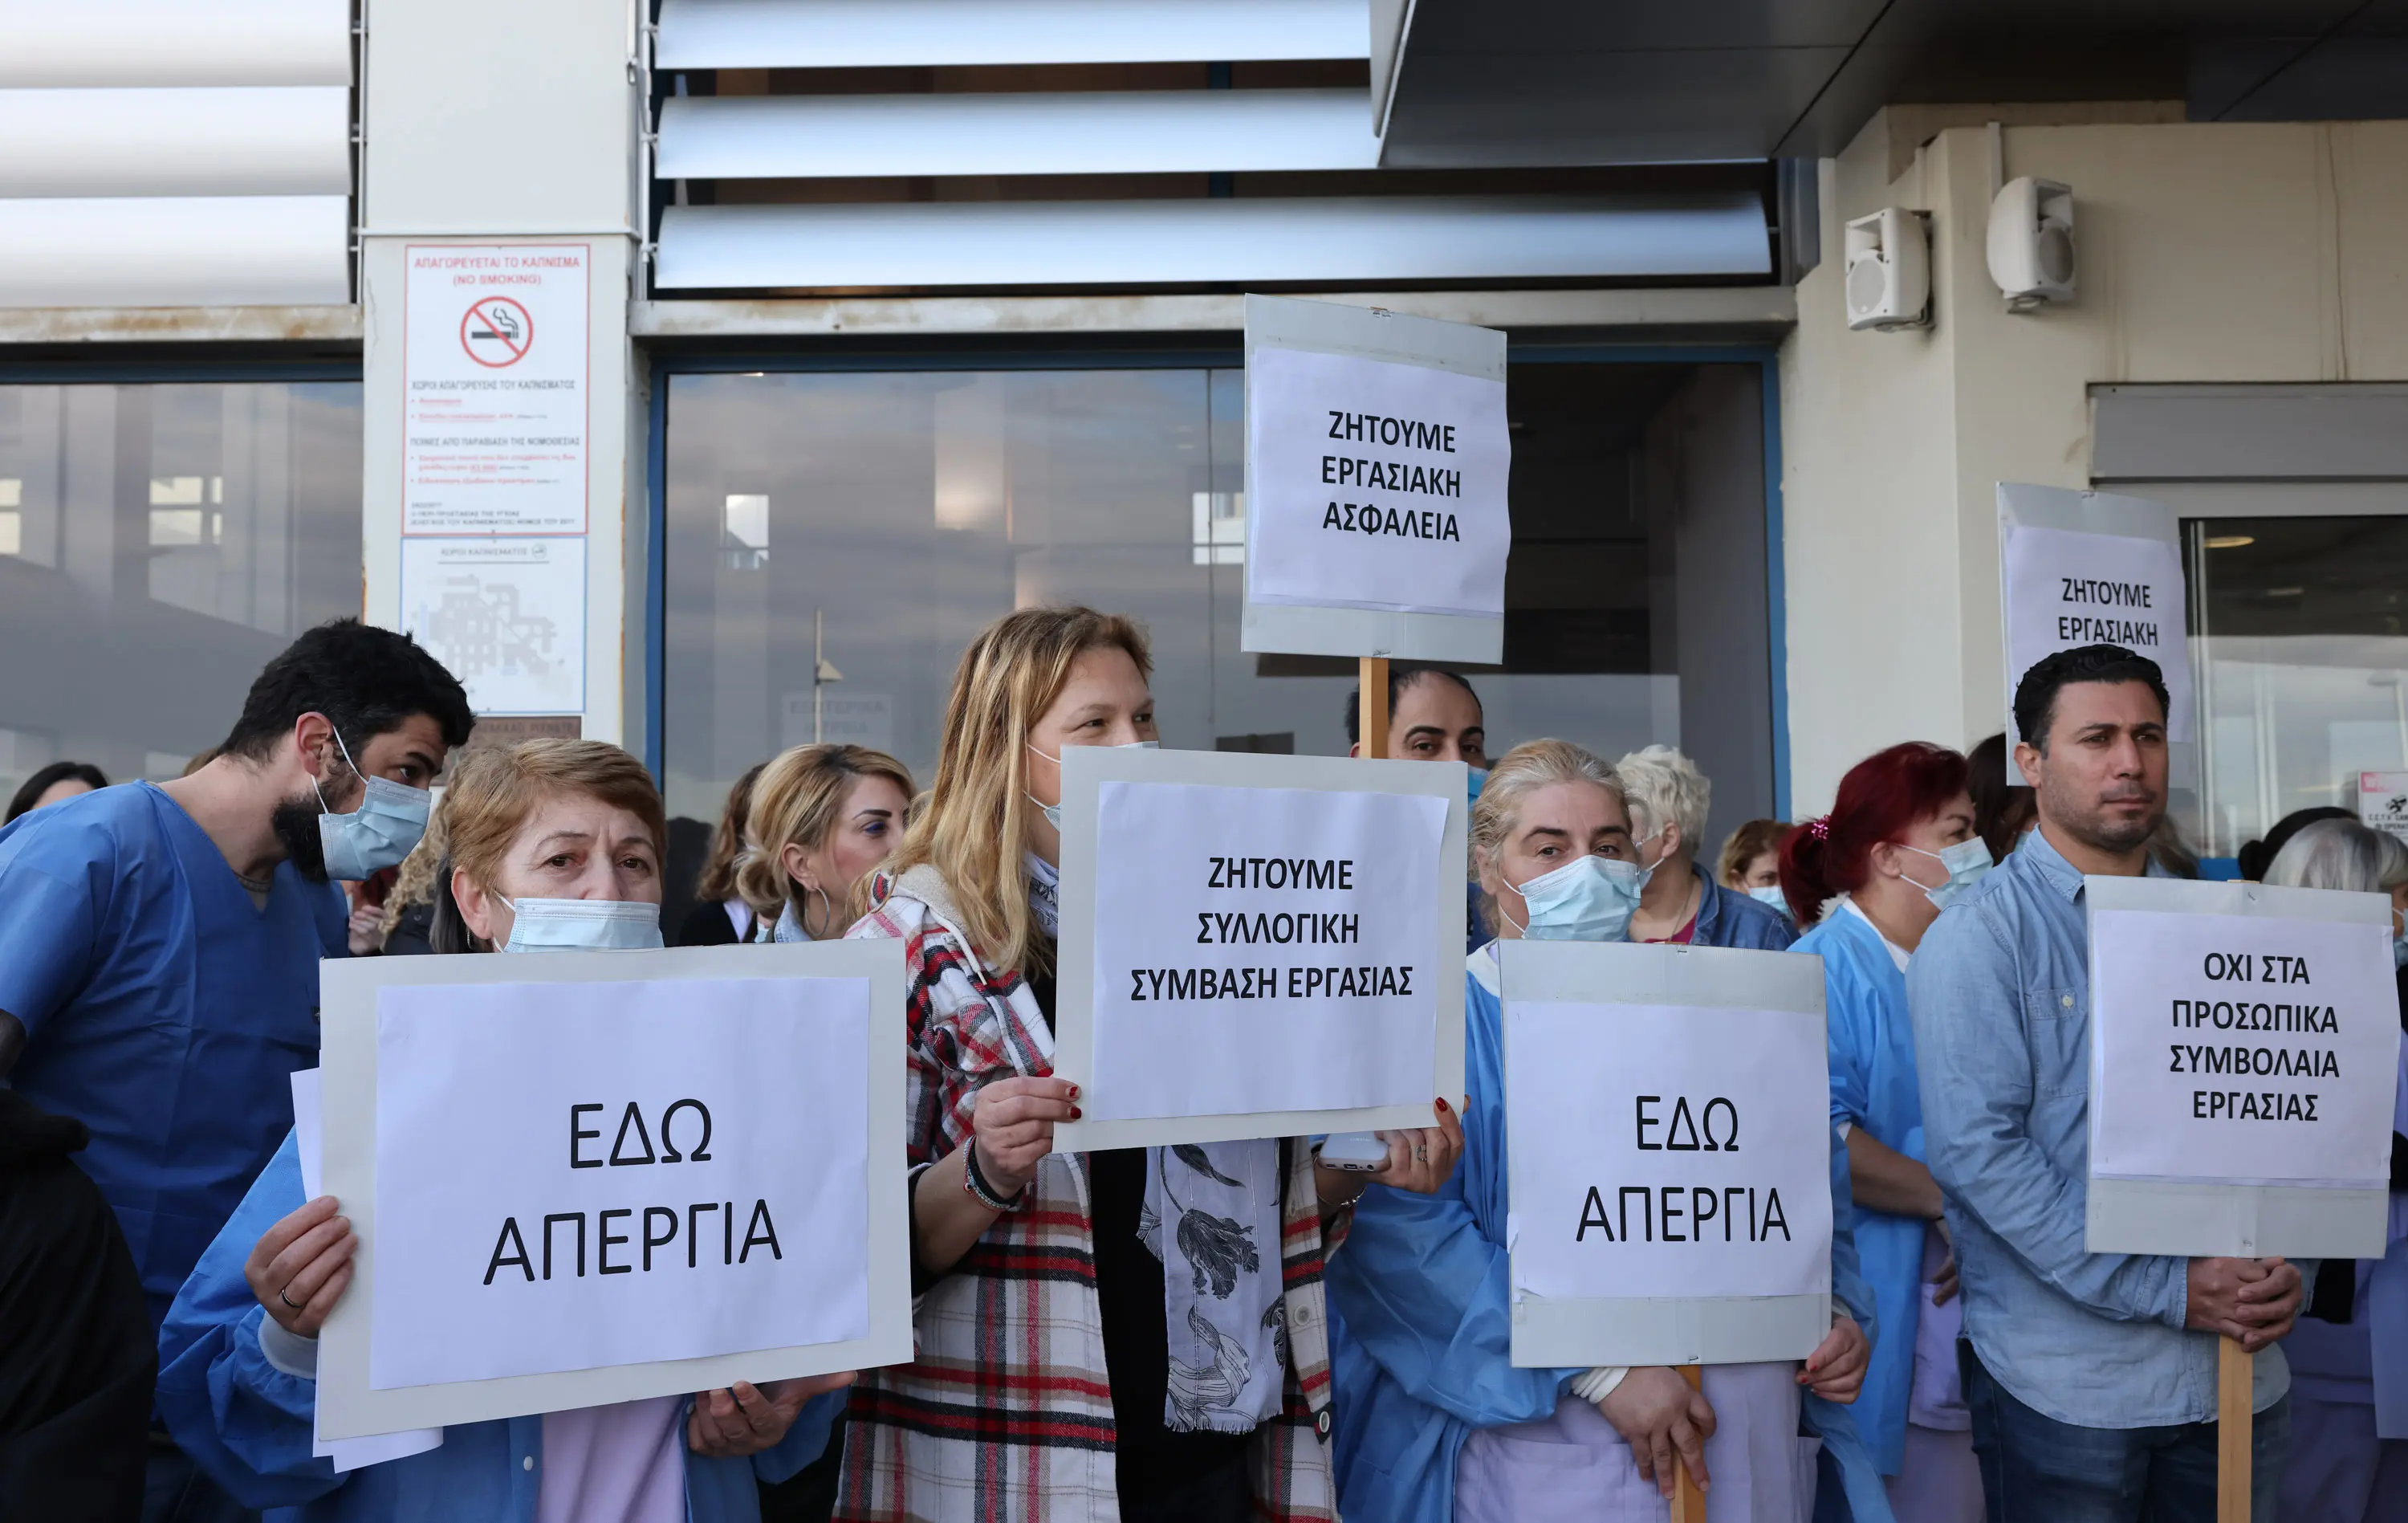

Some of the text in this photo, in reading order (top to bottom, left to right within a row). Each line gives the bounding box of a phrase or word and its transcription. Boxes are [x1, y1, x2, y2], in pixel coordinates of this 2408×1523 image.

[414, 256, 580, 269] ΑΠΑΓΟΡΕΥΕΤΑΙ ΤΟ ΚΑΠΝΙΣΜΑ
[453, 274, 542, 286] (NO SMOKING)
[499, 380, 516, 390] ΤΟΥ
[1328, 410, 1456, 454] ΖΗΤΟΥΜΕ
[1322, 455, 1461, 499] ΕΡΓΑΣΙΑΚΗ
[1322, 501, 1460, 543] ΑΣΦΑΛΕΙΑ
[2061, 577, 2152, 609] ΖΗΤΟΥΜΕ
[2058, 616, 2158, 646] ΕΡΓΑΣΙΑΚΗ
[1208, 857, 1353, 890] ΖΗΤΟΥΜΕ
[1197, 912, 1359, 944] ΣΥΛΛΟΓΙΚΗ
[1130, 966, 1413, 1001] ΣΥΜΒΑΣΗ ΕΡΓΑΣΙΑΣ
[2204, 952, 2311, 985] ΟΧΙ ΣΤΑ
[2172, 1000, 2339, 1034] ΠΡΟΣΩΠΙΚΑ
[2170, 1045, 2340, 1078] ΣΥΜΒΟΛΑΙΑ
[2193, 1090, 2319, 1122] ΕΡΓΑΣΙΑΣ
[570, 1098, 712, 1169] ΕΔΩ
[1636, 1095, 1739, 1152] ΕΔΩ
[1576, 1186, 1792, 1242] ΑΠΕΡΓΙΑ
[482, 1199, 783, 1285] ΑΠΕΡΓΙΑ
